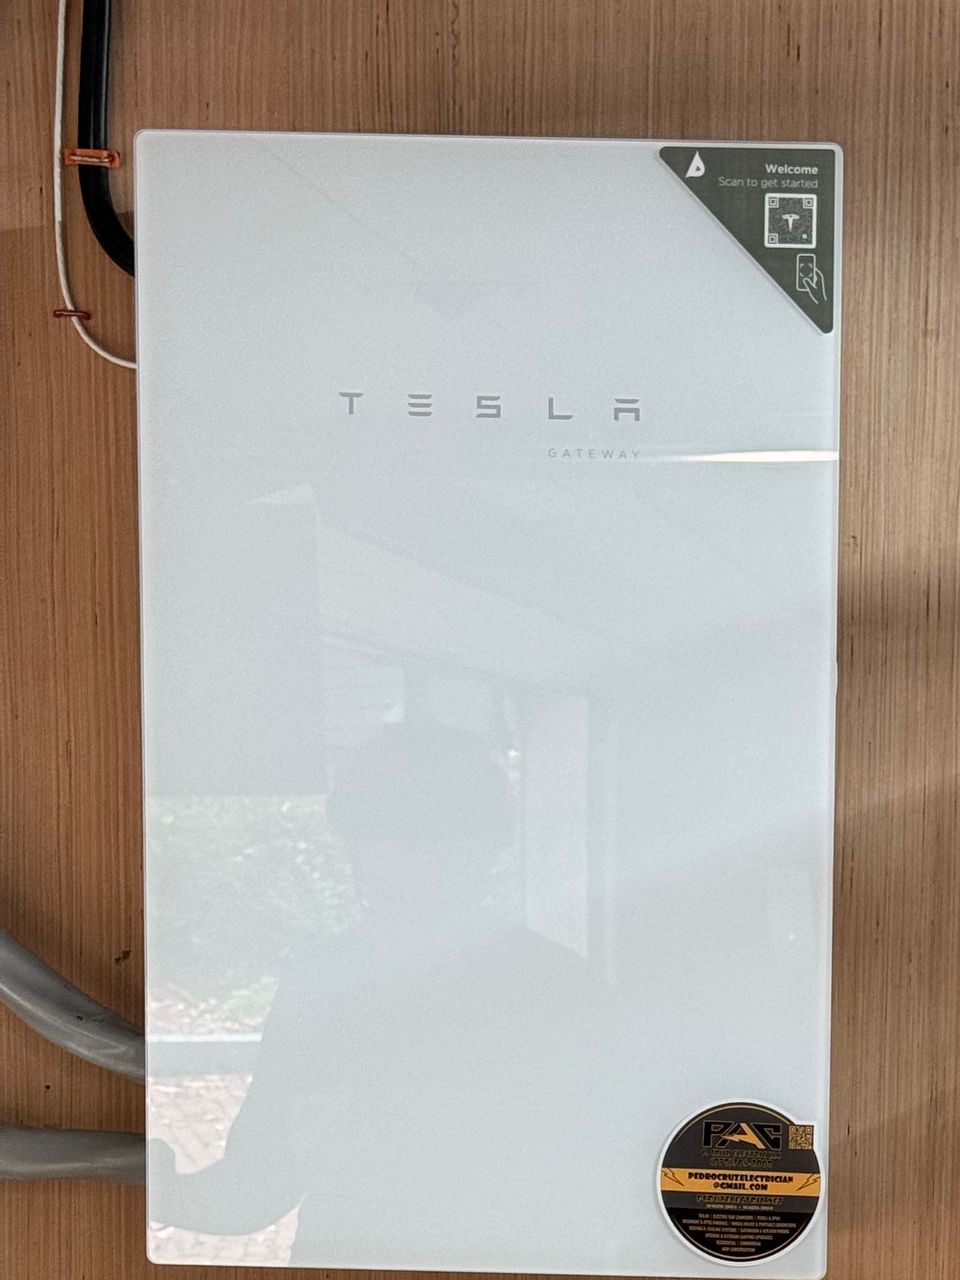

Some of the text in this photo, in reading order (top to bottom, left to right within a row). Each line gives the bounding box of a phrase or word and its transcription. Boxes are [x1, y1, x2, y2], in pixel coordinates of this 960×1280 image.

[765, 163, 819, 175] Welcome
[718, 176, 819, 189] Scan to get started
[339, 392, 640, 421] TESLA
[547, 448, 641, 460] GATEWAY
